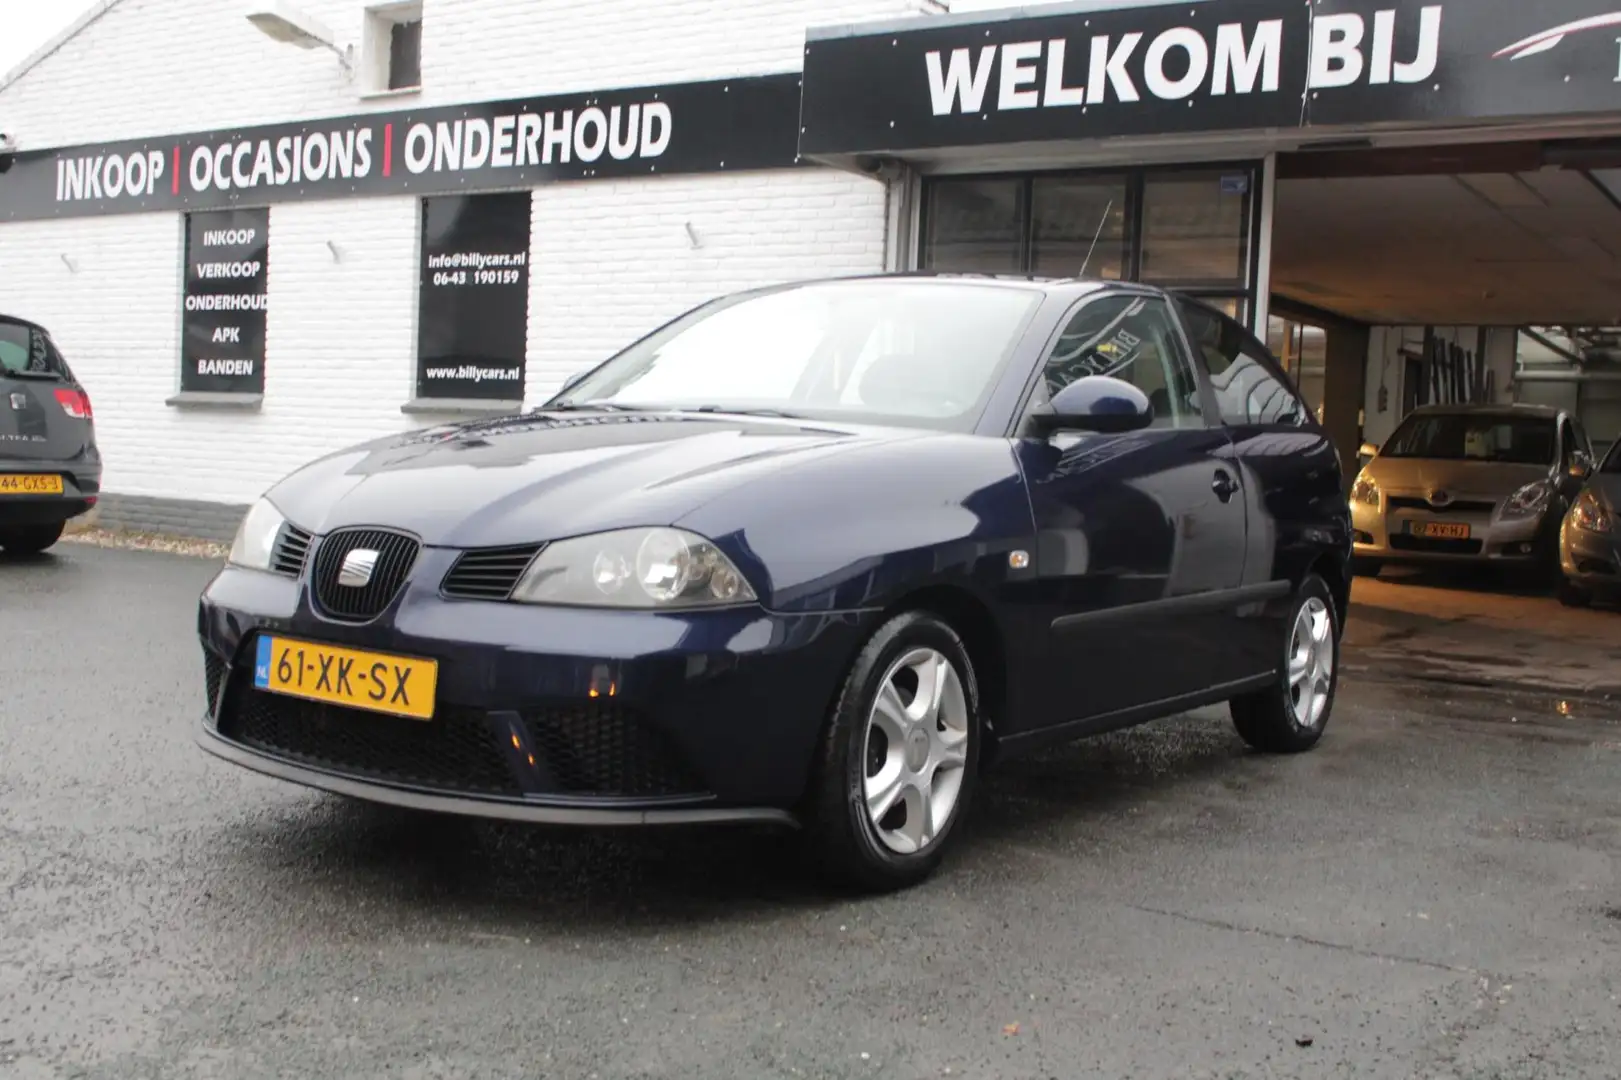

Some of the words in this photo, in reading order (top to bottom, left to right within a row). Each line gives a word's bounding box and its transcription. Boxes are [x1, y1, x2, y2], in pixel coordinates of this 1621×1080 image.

[925, 19, 1283, 117] WELKOM
[1308, 5, 1442, 88] BIJ
[56, 149, 164, 201] INKOOP
[189, 127, 372, 192] OCCASIONS
[404, 101, 672, 175] ONDERHOUD
[203, 229, 255, 246] INKOOP
[428, 251, 526, 269] info@billycars.nl
[196, 261, 260, 279] VERKOOP
[433, 271, 466, 286] 06-43
[474, 270, 519, 284] 190159
[212, 327, 240, 343] APK
[198, 360, 253, 376] BANDEN
[426, 364, 520, 383] www.billycars.nl
[277, 648, 412, 706] 61-XK-SX
